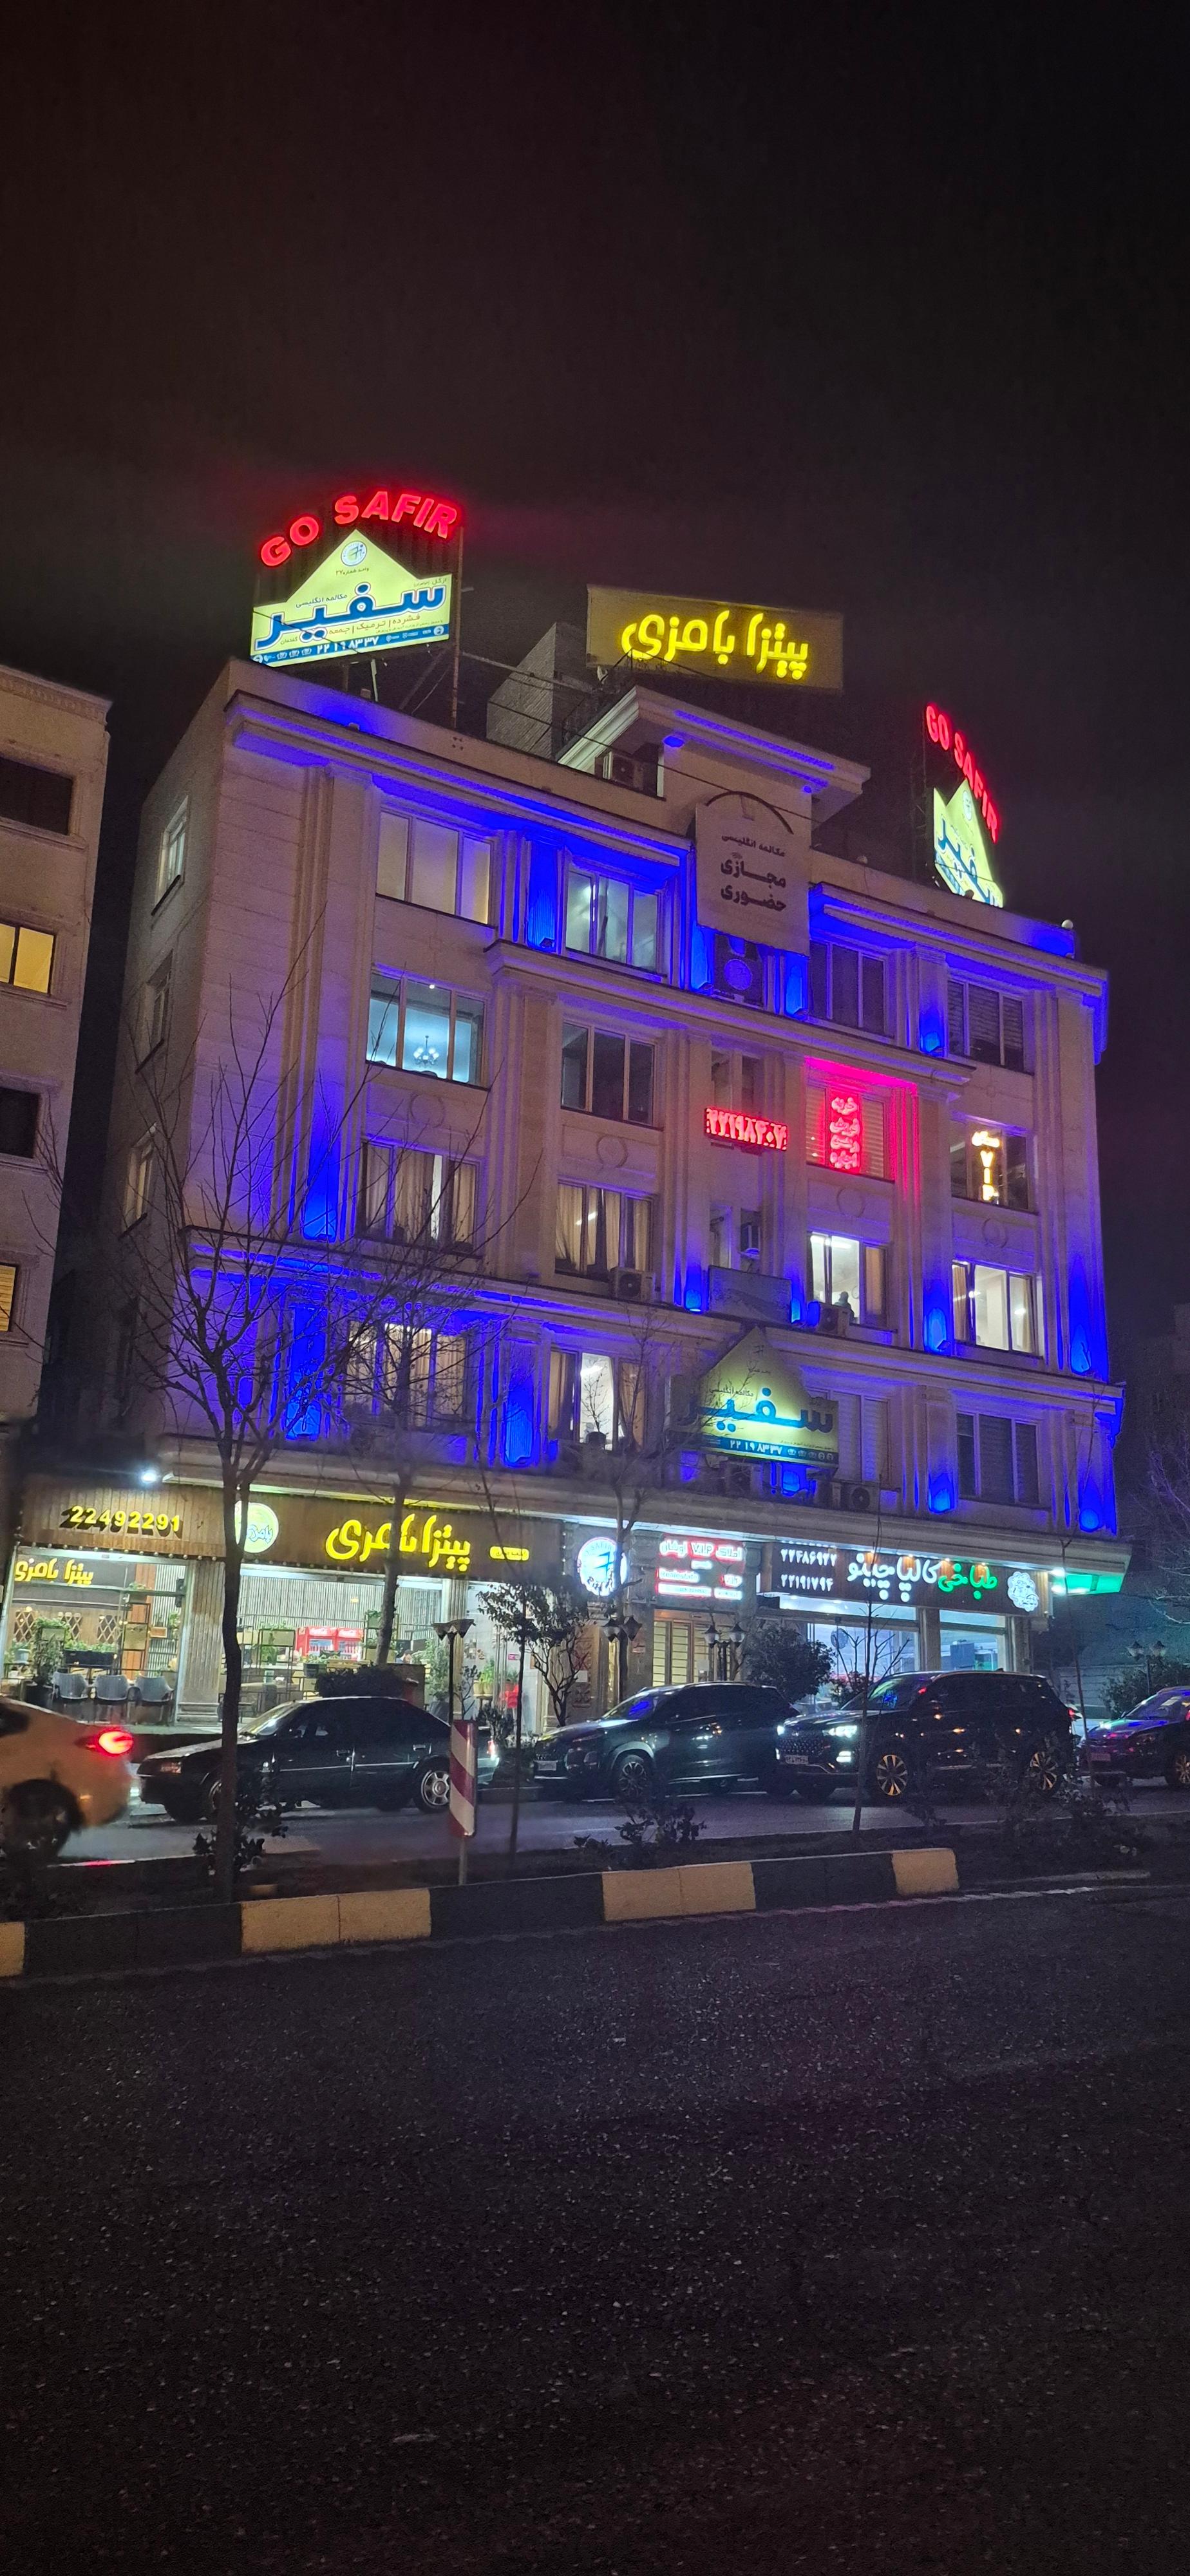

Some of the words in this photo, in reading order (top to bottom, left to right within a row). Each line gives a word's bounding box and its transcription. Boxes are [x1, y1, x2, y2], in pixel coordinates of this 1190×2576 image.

[261, 516, 319, 567] GO
[334, 491, 457, 539] SAFIR
[296, 596, 324, 609] انگلیسی
[325, 593, 348, 602] مکالمه
[256, 582, 447, 650] سفیر
[356, 620, 386, 631] ترمیک
[393, 614, 420, 625] فشرده
[621, 609, 735, 665] بامزی
[746, 612, 809, 681] پیتزا
[926, 705, 950, 751] GO
[954, 732, 997, 845] SAFIR
[721, 835, 756, 848] انگلیسی
[758, 843, 786, 857] مکالمه
[720, 858, 786, 889] مجازی
[720, 884, 787, 912] حضوری
[70, 1505, 180, 1533] 22492291
[421, 1514, 471, 1572] پیتزا
[938, 1562, 997, 1601] طباخی
